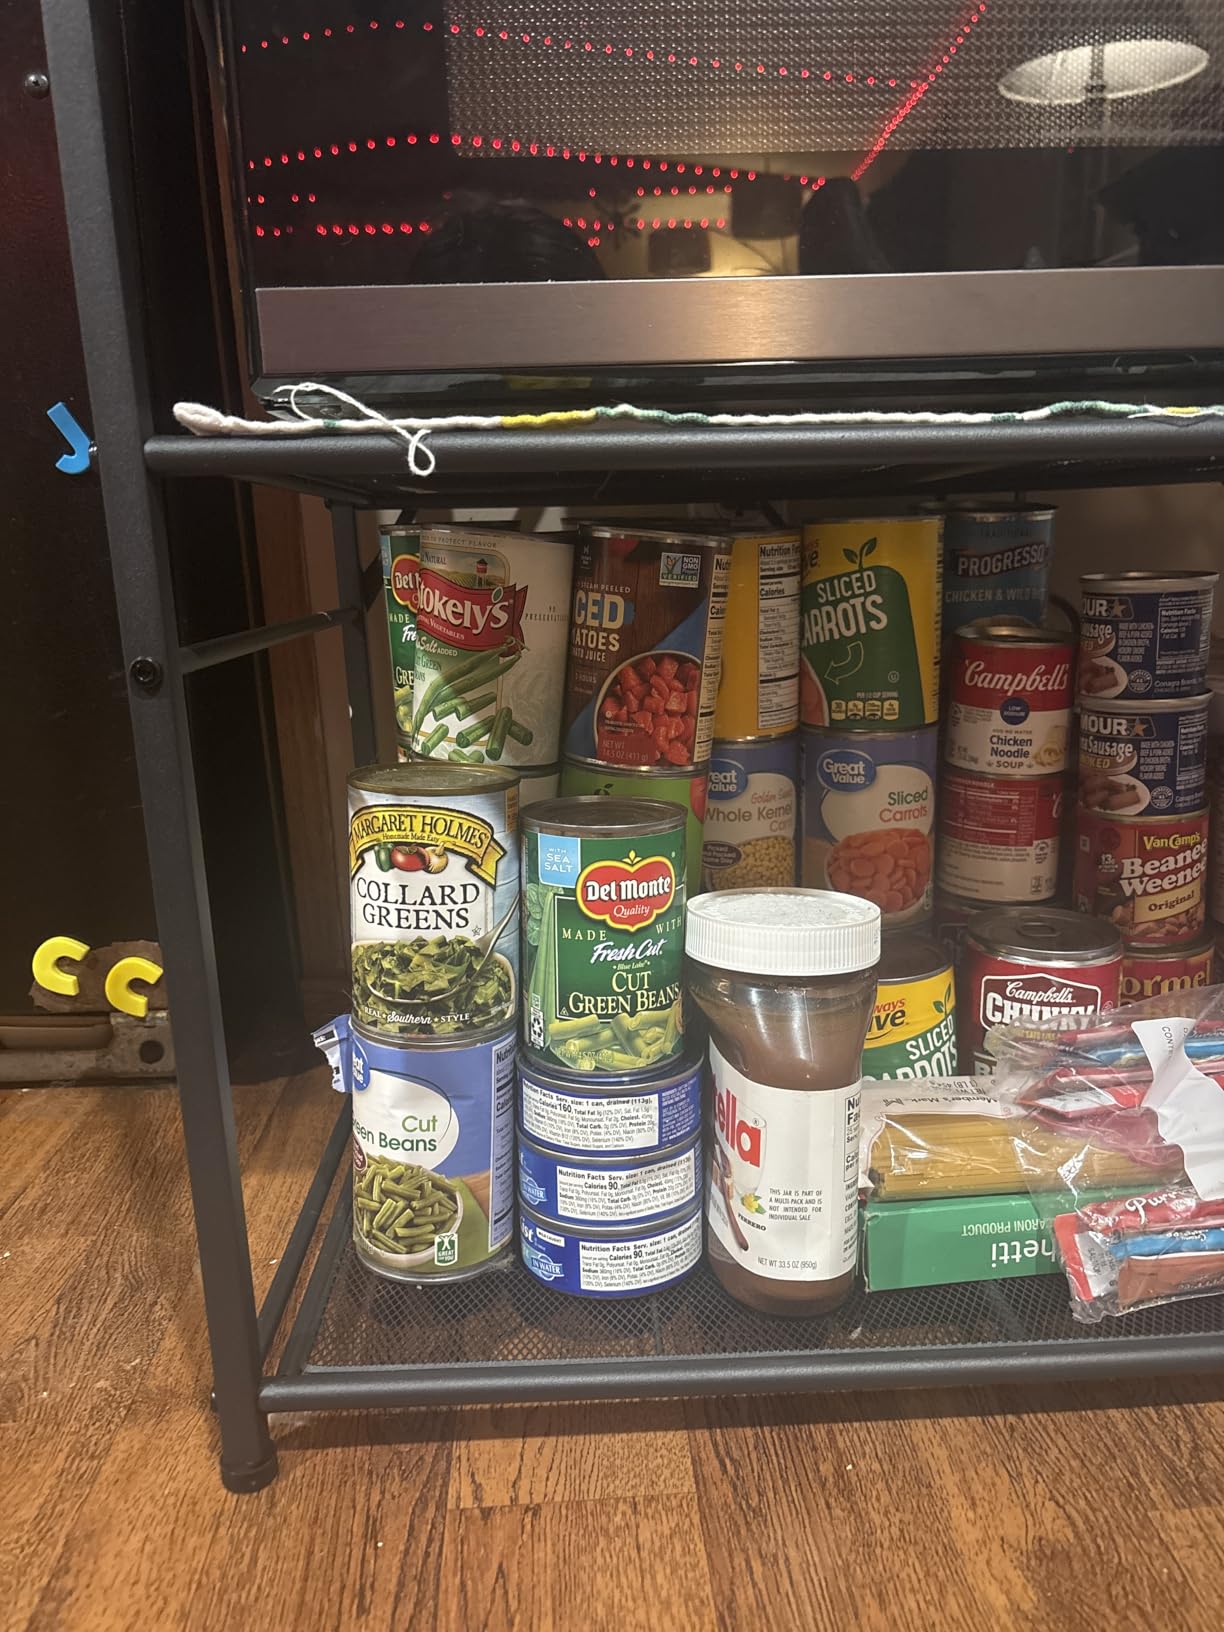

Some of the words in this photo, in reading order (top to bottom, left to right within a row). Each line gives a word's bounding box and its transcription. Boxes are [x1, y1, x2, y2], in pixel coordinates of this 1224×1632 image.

[682, 562, 699, 570] GMO
[683, 556, 699, 564] NON
[957, 544, 1046, 577] PROGRESSO
[662, 573, 697, 582] VERIFIED
[816, 570, 876, 604] SLICED
[944, 589, 993, 603] CHICKEN
[574, 589, 625, 630] CED
[800, 594, 888, 648] ARROTS
[401, 624, 417, 643] Fre
[573, 629, 620, 652] ATOES
[585, 647, 607, 663] JUICE
[395, 665, 415, 686] GRE
[964, 657, 1070, 697] Campbell's
[1080, 714, 1129, 736] MOUR
[989, 734, 1033, 748] Chicken
[1088, 735, 1134, 763] Sausage
[990, 746, 1030, 760] Noodle
[822, 758, 865, 775] Great
[996, 760, 1024, 770] SOUP
[708, 770, 737, 784] reat
[831, 772, 866, 785] Value
[887, 786, 928, 806] Sliced
[705, 807, 752, 823] Whole
[879, 805, 928, 823] Carrots
[353, 813, 417, 843] MARGARET
[421, 815, 487, 849] HOLMES
[382, 833, 410, 841] Homemade
[411, 833, 426, 841] Made
[427, 835, 440, 843] Easy
[546, 852, 571, 865] SEA
[1121, 838, 1208, 879] Beanee
[543, 862, 575, 874] SALT
[356, 876, 481, 906] COLLARD
[585, 880, 618, 902] Del
[618, 875, 672, 901] Monte
[1148, 890, 1195, 912] Original
[362, 903, 470, 931] GREENS
[612, 904, 650, 918] Quality
[562, 927, 607, 941] MADE
[655, 916, 683, 935] WITH
[611, 971, 652, 993] CUT
[1122, 960, 1211, 997] ormel
[569, 991, 632, 1015] GREEN
[636, 982, 680, 1012] BEANS
[1005, 980, 1074, 1005] Campbell's
[873, 998, 906, 1014] ways
[986, 992, 1095, 1031] CHUNKY
[364, 1006, 382, 1019] REAL
[386, 1010, 432, 1025] Southern
[440, 1012, 471, 1024] STYLE
[868, 1008, 906, 1033] ve
[905, 1014, 955, 1061] SLICED
[539, 1090, 554, 1100] Facts
[555, 1095, 568, 1104] Serv.
[606, 1098, 630, 1107] drained
[539, 1097, 558, 1111] Calories
[402, 1114, 438, 1133] Cut
[352, 1116, 375, 1145] reen
[378, 1131, 438, 1153] Beans
[558, 1168, 586, 1181] Nutrition
[587, 1173, 606, 1182] Facts
[584, 1181, 607, 1190] Calories
[769, 1187, 781, 1196] THIS
[737, 1212, 767, 1232] FERRERO
[768, 1213, 798, 1221] INDIVIDUAL
[1013, 1218, 1047, 1232] ARONI
[961, 1221, 1011, 1237] PRODUCT
[438, 1249, 454, 1257] GREAT
[581, 1243, 611, 1253] Nutrition
[612, 1243, 631, 1252] Facts
[633, 1242, 648, 1251] Serv.
[991, 1238, 1056, 1268] hetti
[609, 1254, 633, 1262] Calories
[757, 1256, 768, 1267] NET
[768, 1258, 778, 1268] WT
[778, 1258, 791, 1269] 33.5
[791, 1259, 800, 1269] OZ
[800, 1258, 818, 1270] (950g)
[539, 1259, 561, 1275] WATER
